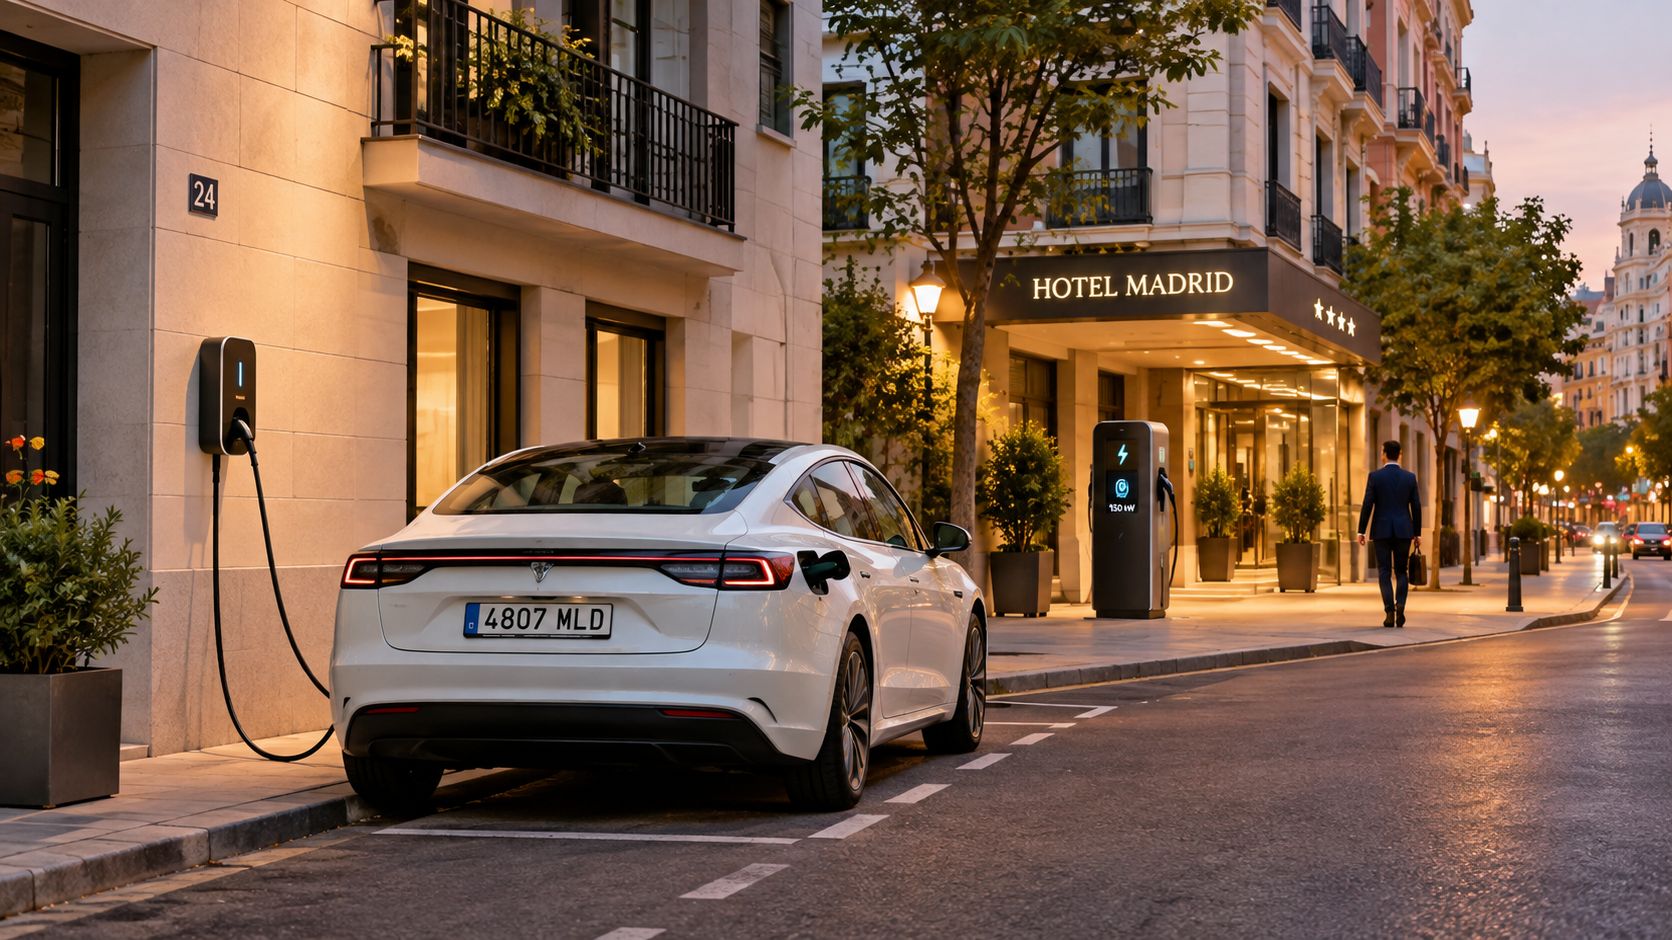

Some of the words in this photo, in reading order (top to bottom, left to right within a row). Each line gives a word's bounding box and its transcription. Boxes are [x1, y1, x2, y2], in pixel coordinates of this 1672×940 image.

[194, 180, 215, 210] 24
[1033, 276, 1118, 299] HOTEL
[1125, 272, 1234, 296] MADRID
[485, 607, 547, 630] 4807
[557, 608, 604, 630] MLD
